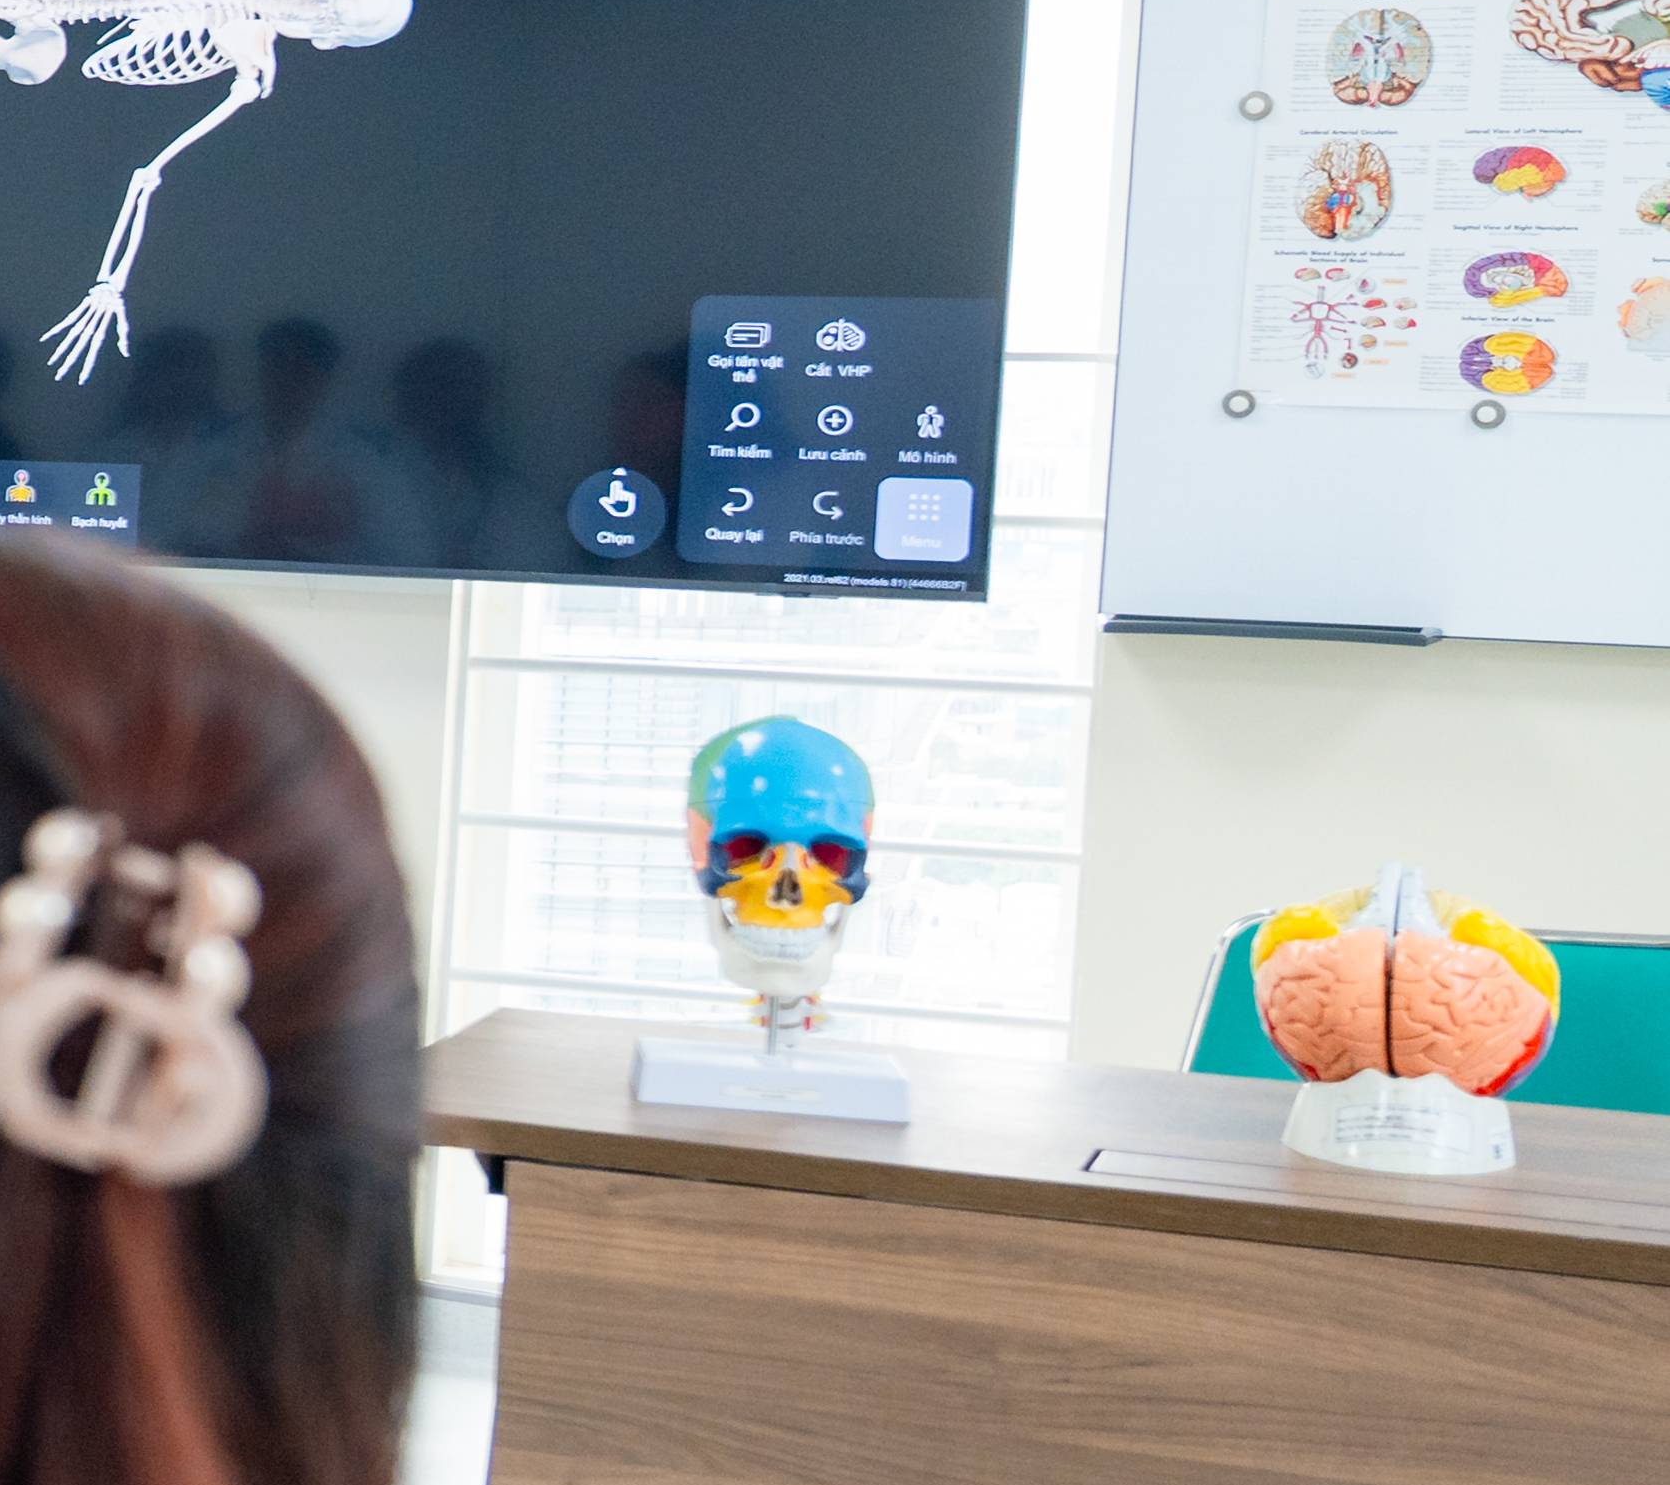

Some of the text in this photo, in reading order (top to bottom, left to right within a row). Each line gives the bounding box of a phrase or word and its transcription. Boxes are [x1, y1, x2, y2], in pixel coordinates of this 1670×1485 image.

[837, 364, 872, 378] VHP
[704, 527, 743, 543] Quay
[789, 529, 824, 545] Phía
[900, 533, 943, 549] Menu
